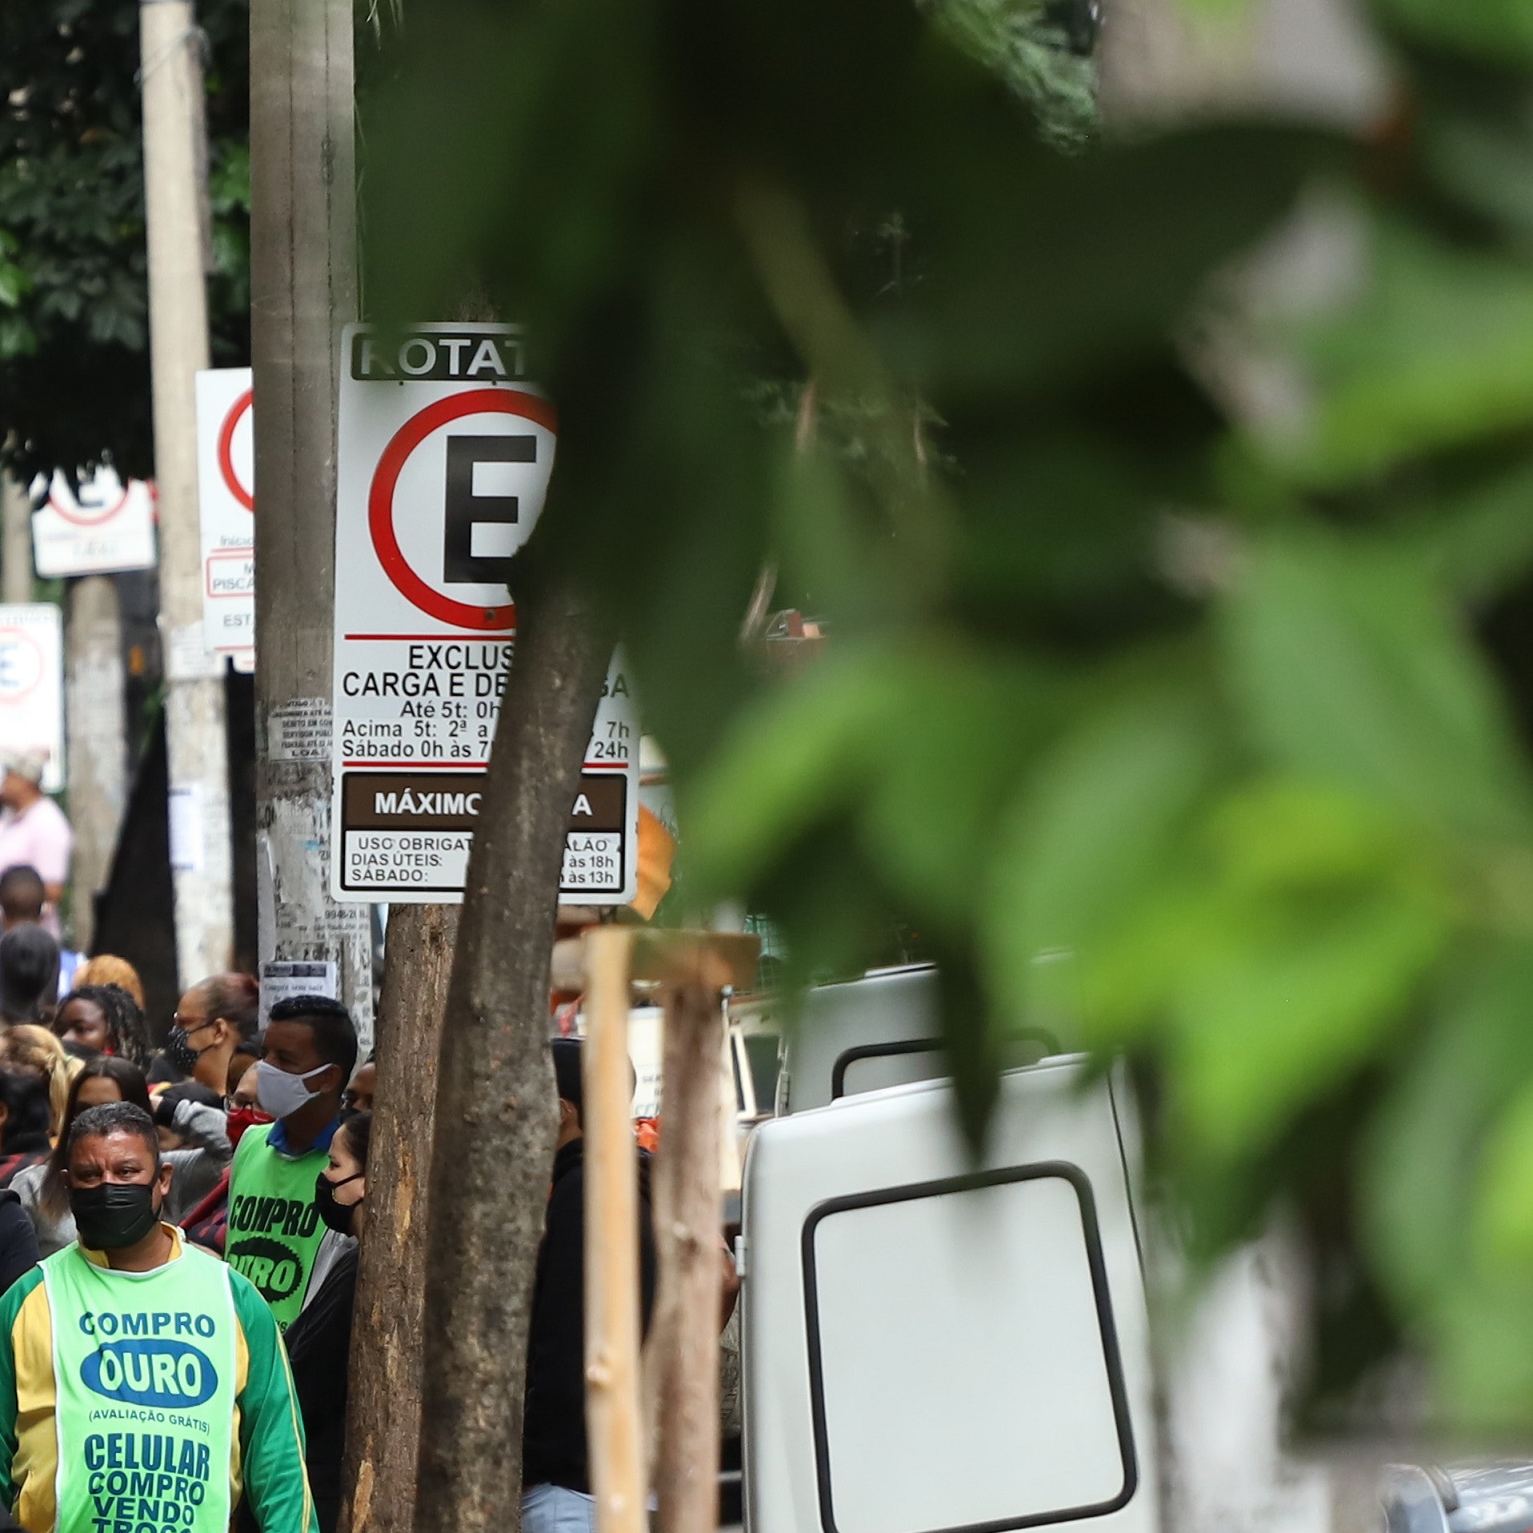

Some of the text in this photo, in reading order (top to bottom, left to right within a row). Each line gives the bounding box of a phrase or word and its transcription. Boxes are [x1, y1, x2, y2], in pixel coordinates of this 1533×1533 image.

[443, 435, 537, 583] E
[342, 672, 440, 697] CARGA
[449, 673, 465, 697] E
[400, 700, 435, 718] Até
[441, 702, 467, 718] 5t:
[342, 720, 403, 738] Acima
[413, 721, 437, 738] 5t:
[477, 725, 488, 738] a
[607, 722, 630, 739] 7h
[342, 739, 414, 758] Sábado
[421, 741, 444, 758] 0h
[451, 739, 472, 758] às
[594, 741, 629, 759] 24h
[351, 851, 614, 868] DIAS ÚTEIS: às 18h
[352, 866, 614, 884] SÁBADO: às 13h
[79, 1311, 215, 1338] COMPRO
[99, 1349, 202, 1397] OURO
[88, 1409, 210, 1436] (AVALIAÇÃO GRÁTIS)
[84, 1433, 210, 1482] CELULAR
[88, 1471, 205, 1506] COMPRO
[93, 1496, 195, 1526] VENDO
